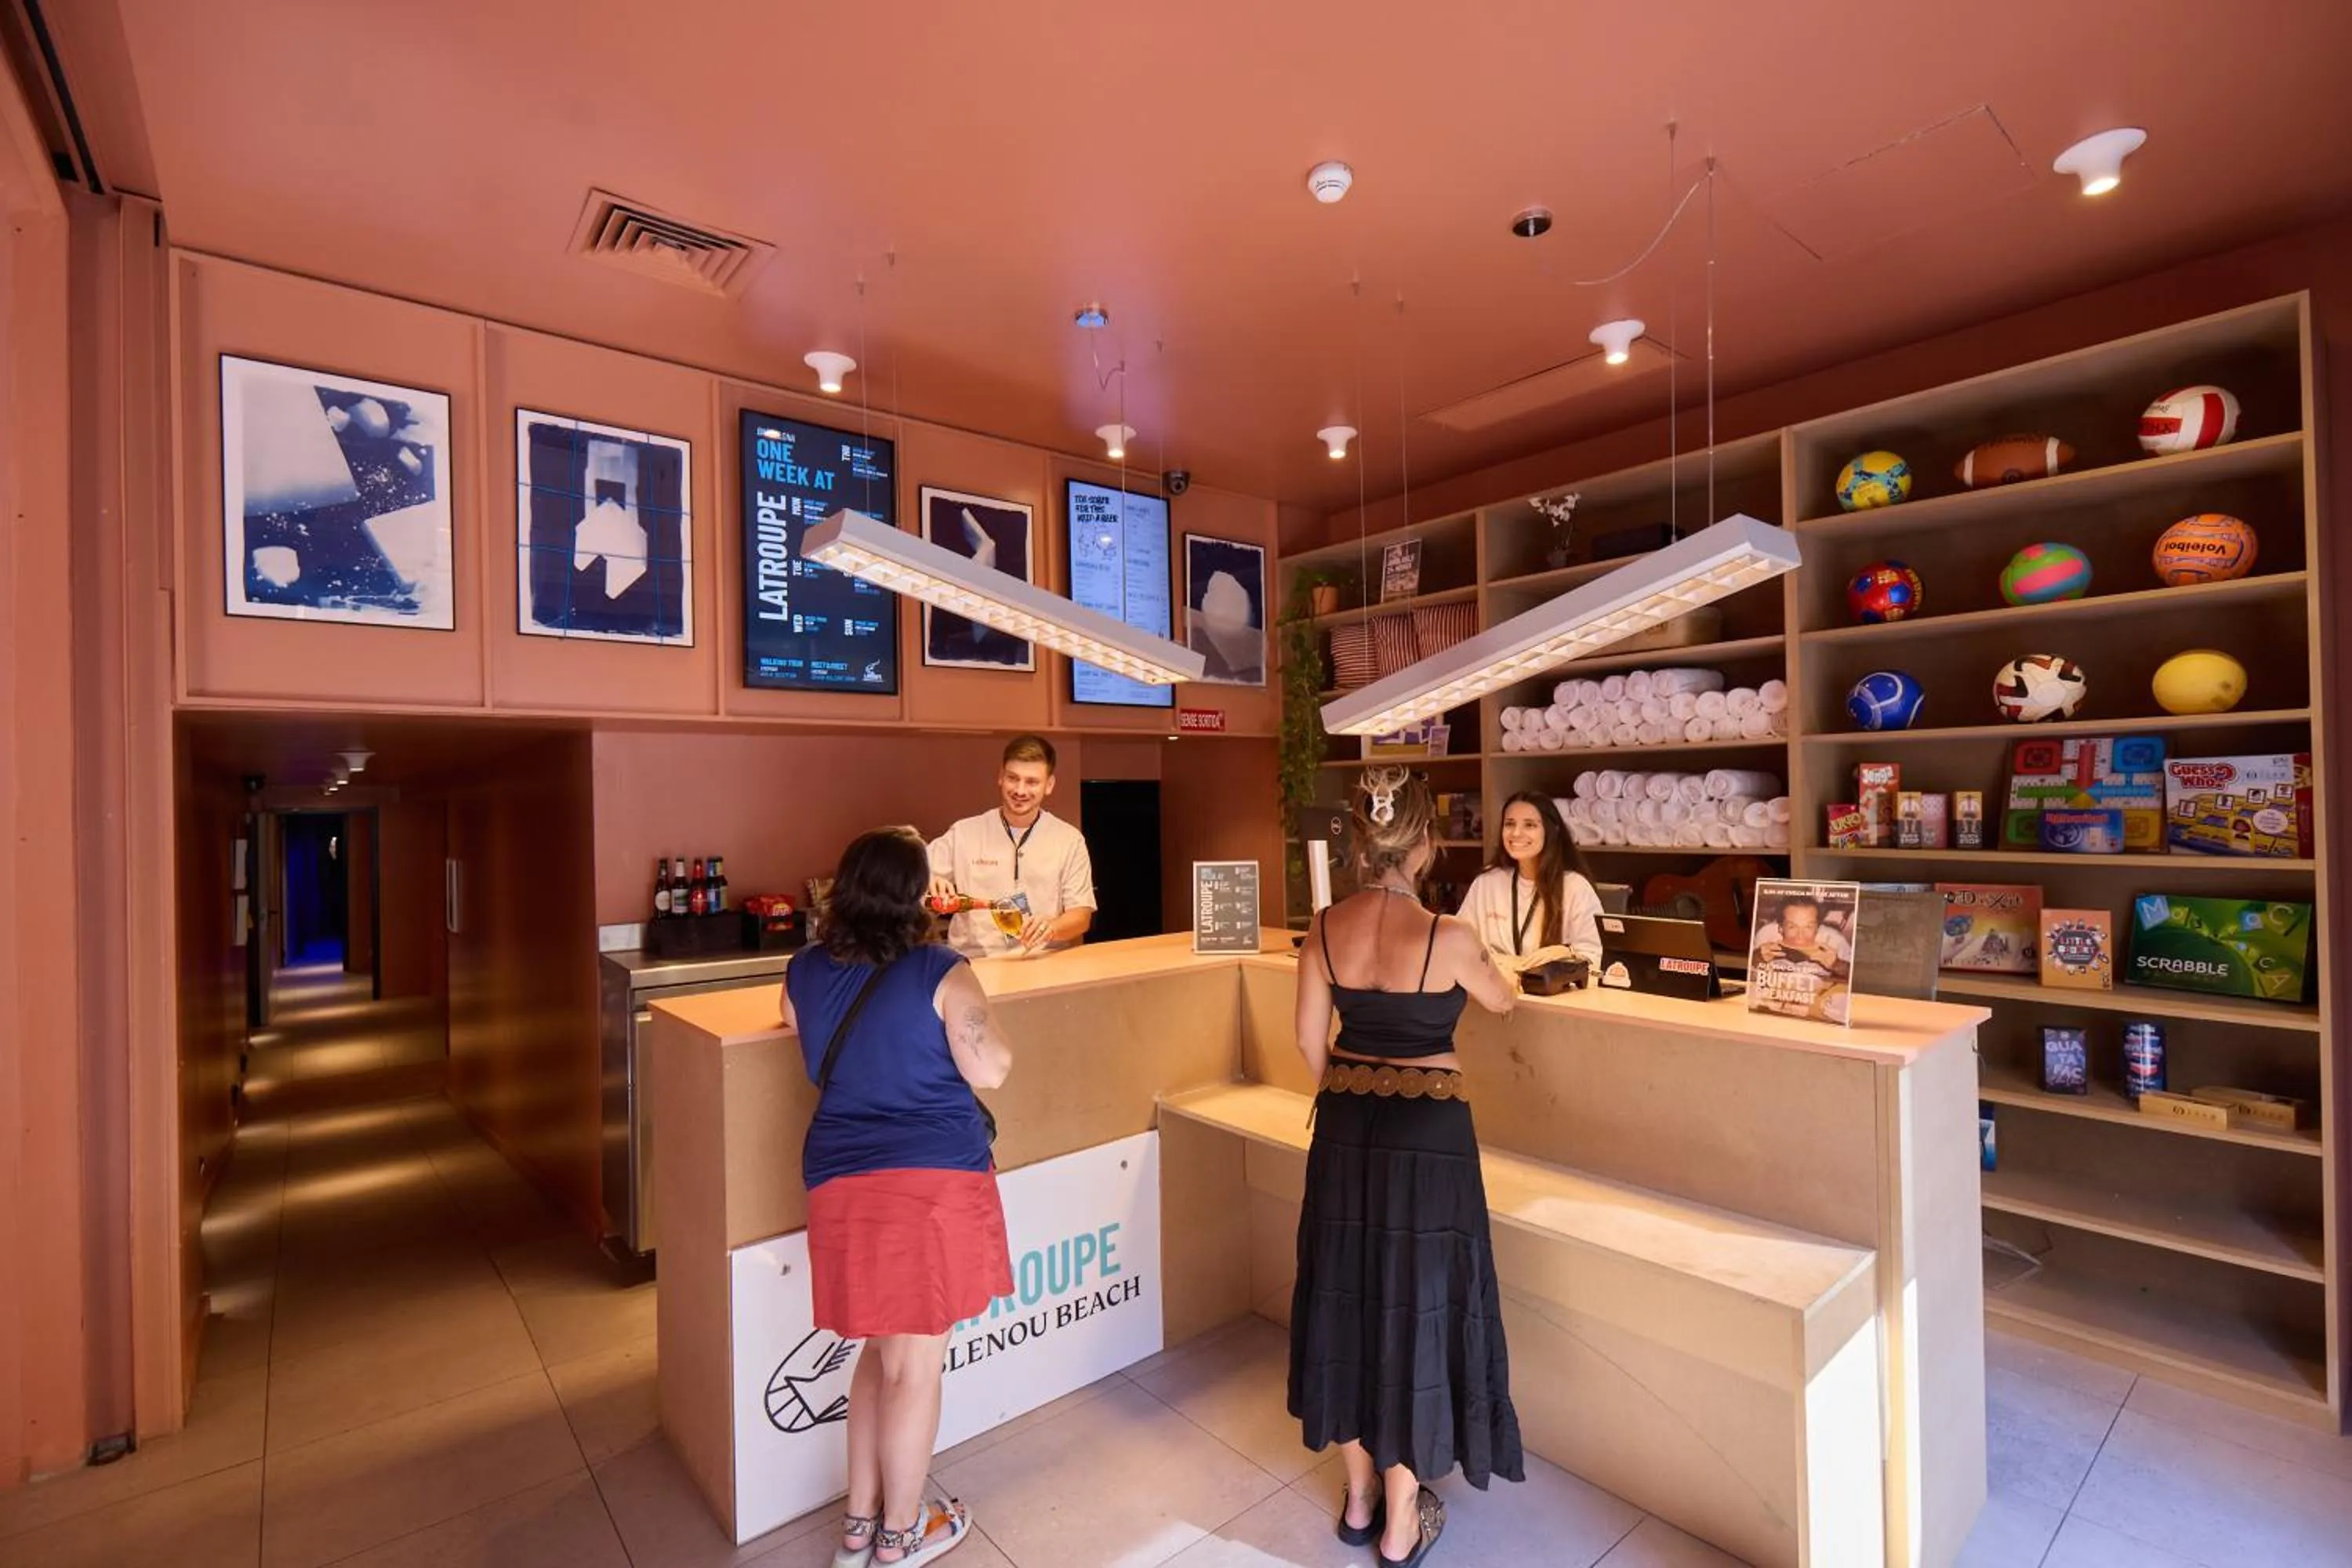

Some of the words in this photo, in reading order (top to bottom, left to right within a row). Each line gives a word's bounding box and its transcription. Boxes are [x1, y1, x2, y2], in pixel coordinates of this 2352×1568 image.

[757, 438, 794, 463] ONE
[757, 459, 809, 487] WEEK
[813, 470, 835, 491] AT
[757, 491, 788, 622] LATROUPE
[2164, 541, 2227, 555] Voleibol
[1200, 880, 1214, 934] LATROUPE
[1661, 959, 1708, 971] LATROUPE
[2136, 956, 2229, 977] SCRABBLE
[1757, 970, 1815, 992] BUFFET
[941, 1312, 1048, 1373] LENOU
[1056, 1275, 1142, 1330] BEACH
